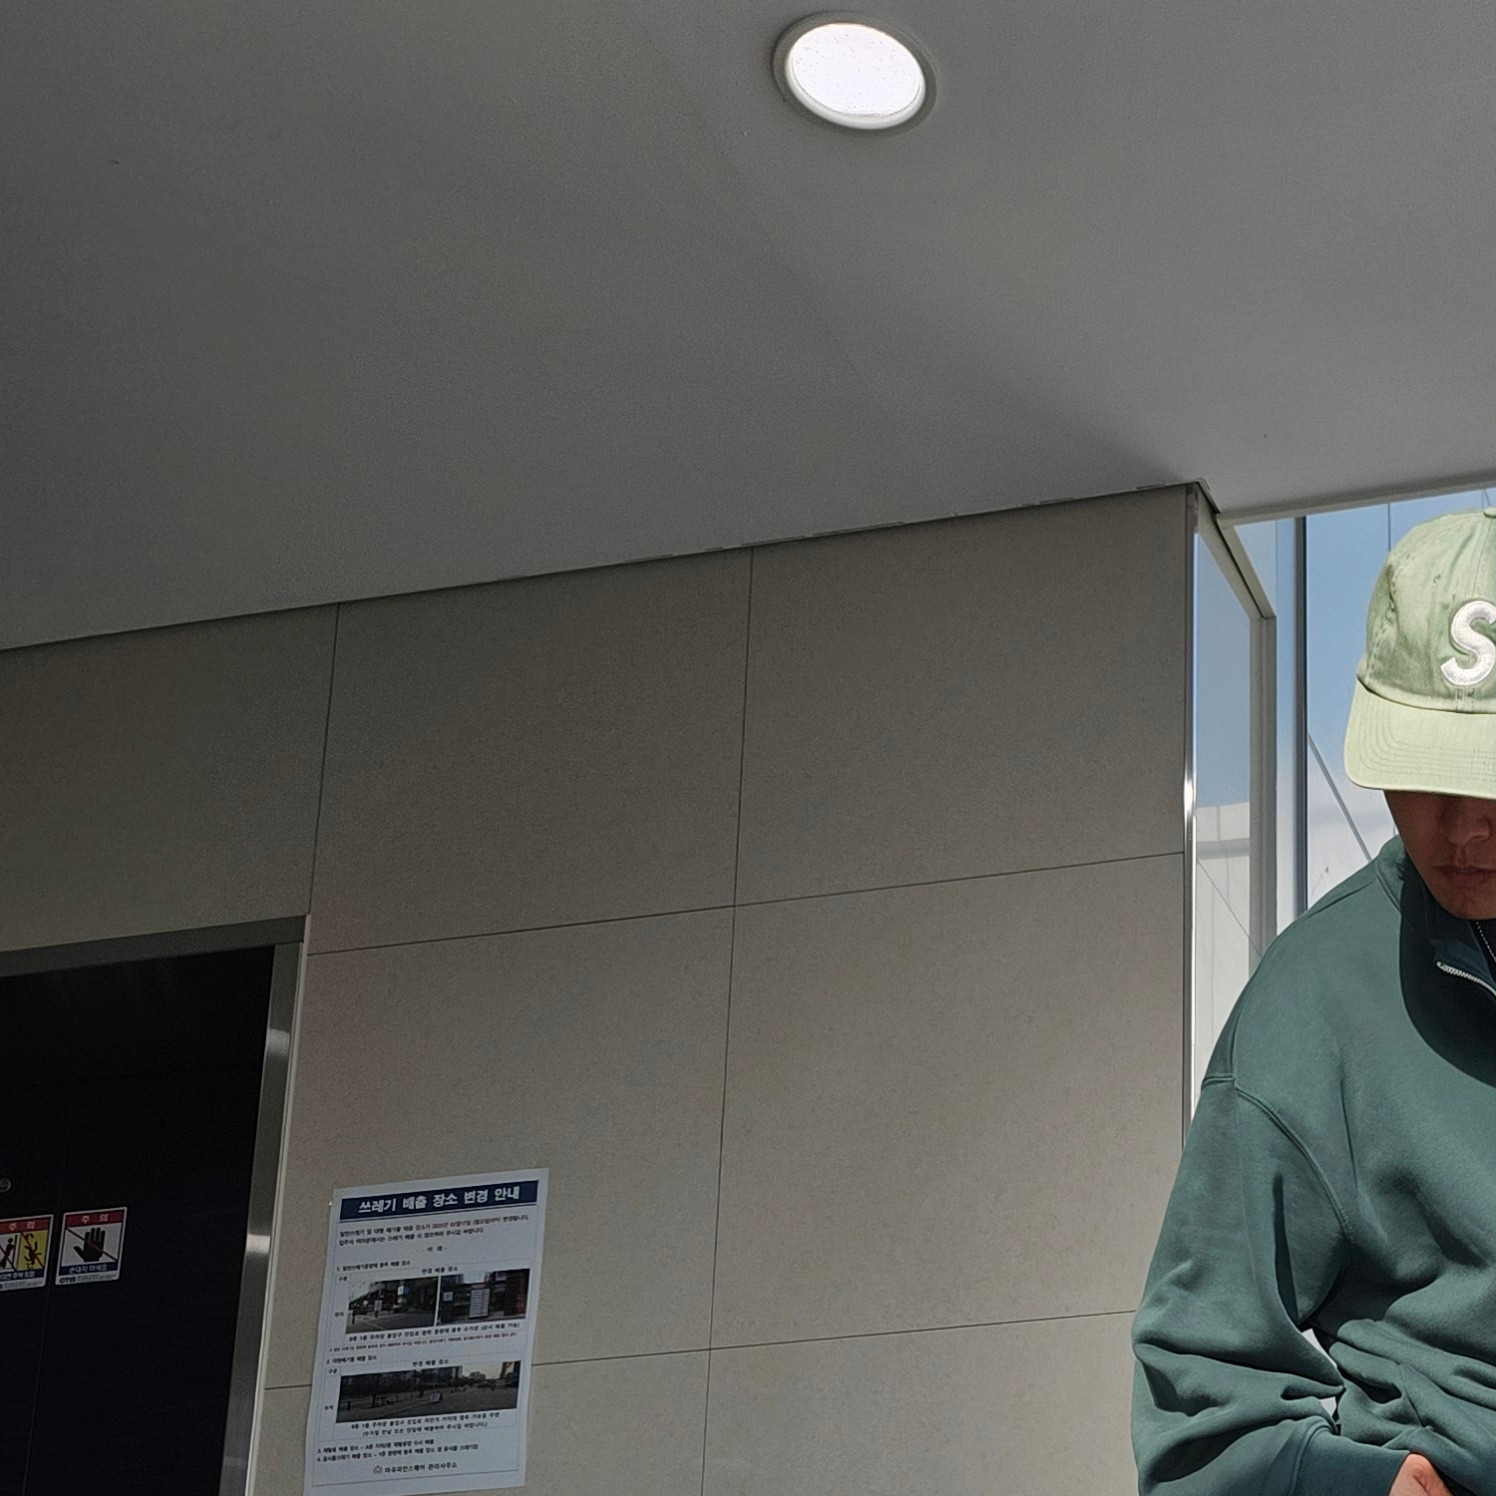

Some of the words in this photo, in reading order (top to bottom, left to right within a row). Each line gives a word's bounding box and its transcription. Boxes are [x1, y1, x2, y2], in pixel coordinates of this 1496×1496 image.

[358, 1197, 396, 1214] 쓰레기
[402, 1194, 427, 1210] 배출
[432, 1191, 458, 1207] 장소
[463, 1189, 488, 1204] 변경
[494, 1186, 519, 1201] 안내
